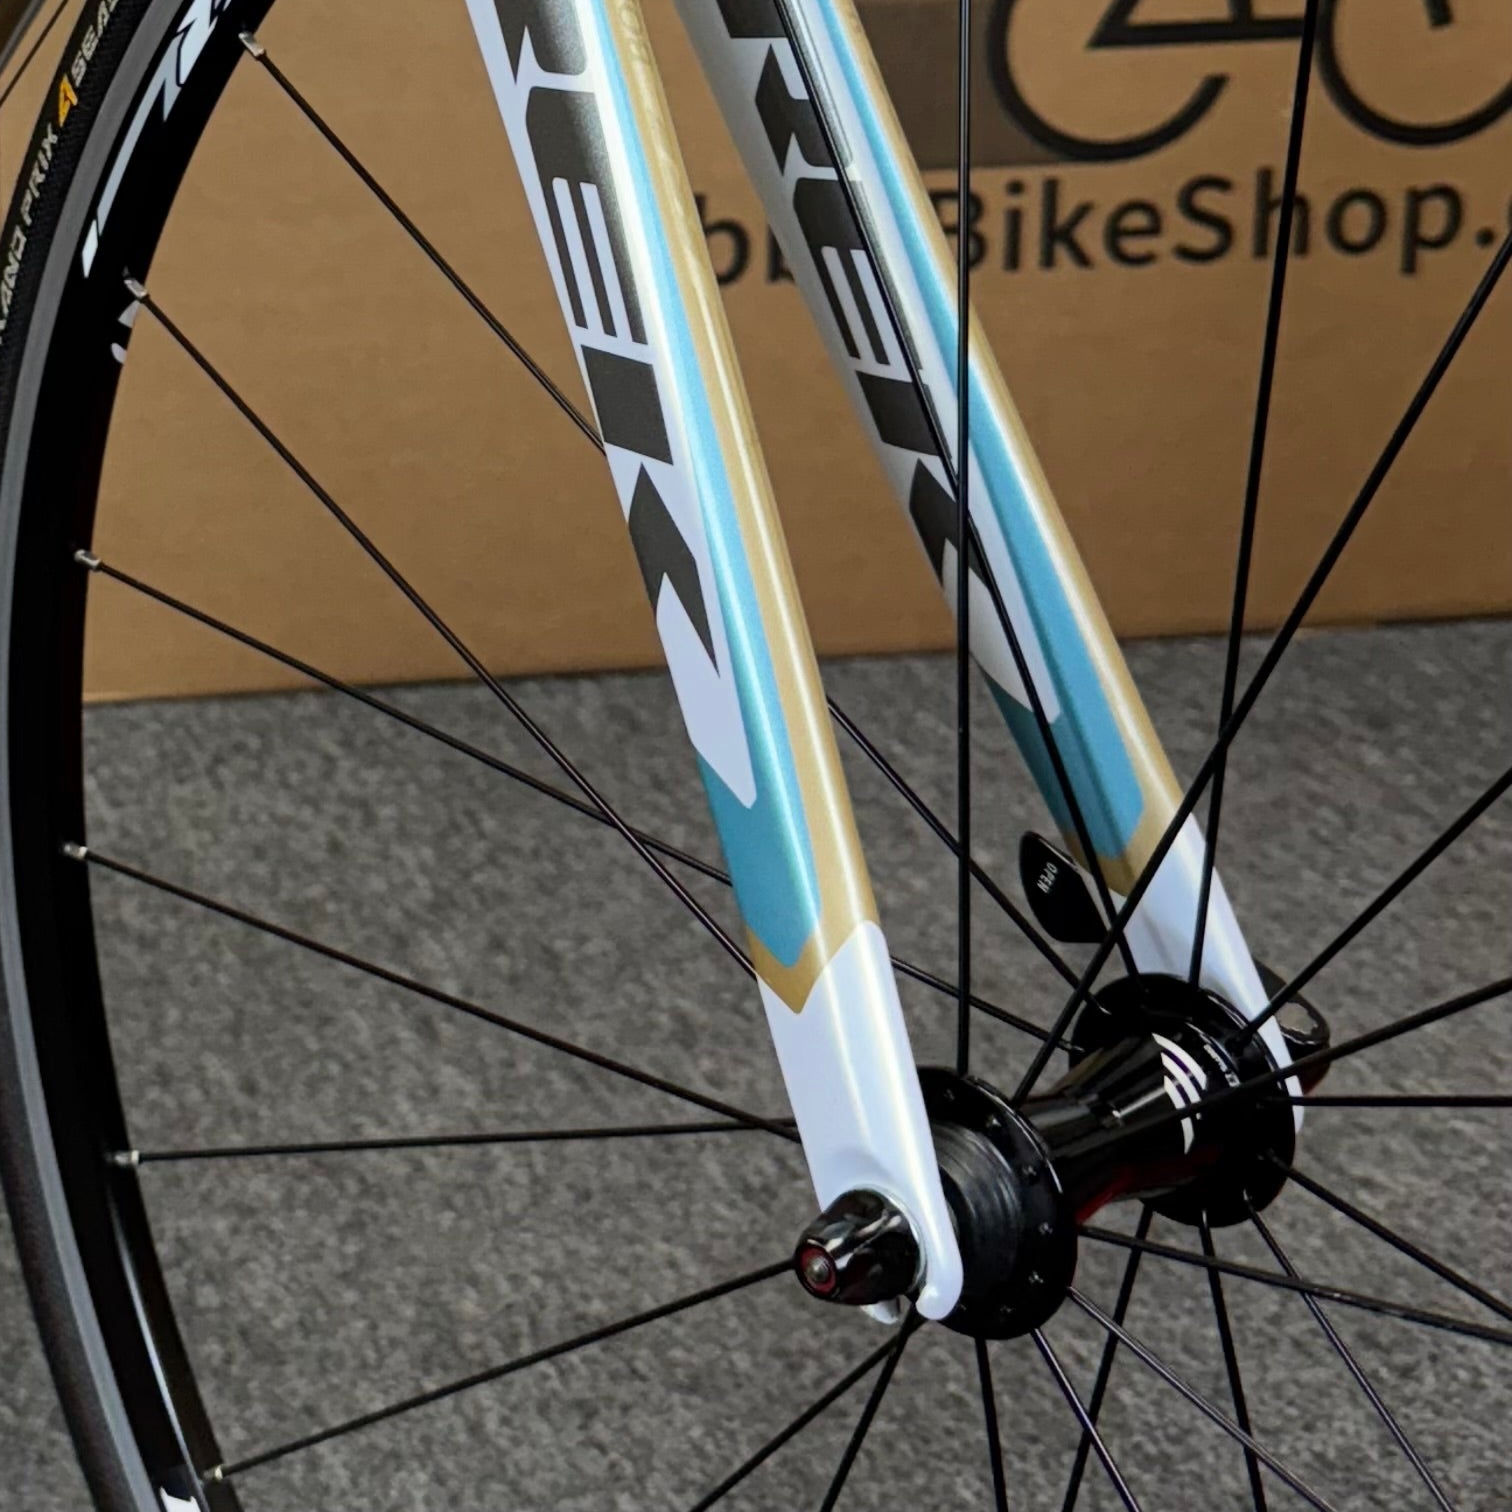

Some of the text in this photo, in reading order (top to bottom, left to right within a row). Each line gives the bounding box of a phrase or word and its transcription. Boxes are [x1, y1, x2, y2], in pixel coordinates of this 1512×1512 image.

[19, 122, 59, 226] PRIX
[57, 72, 79, 129] 4
[1035, 861, 1059, 894] OPEN
